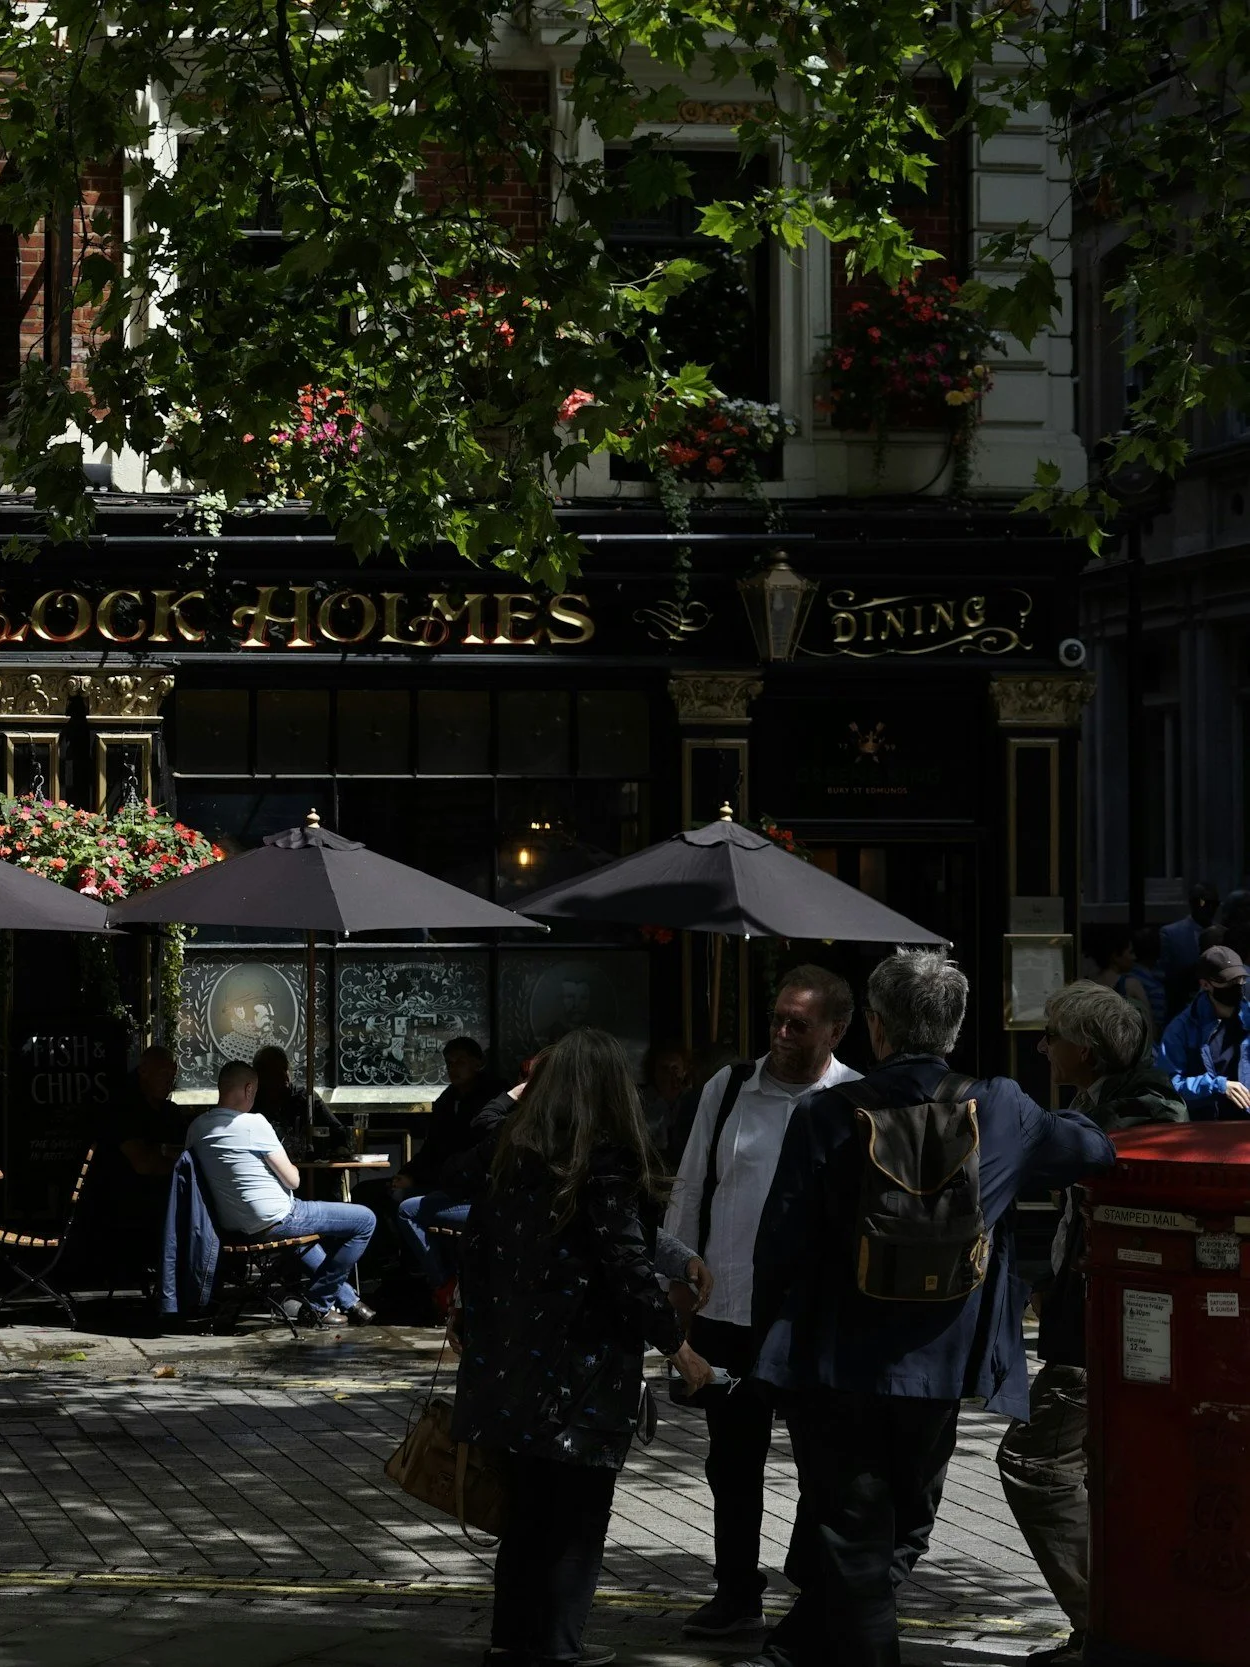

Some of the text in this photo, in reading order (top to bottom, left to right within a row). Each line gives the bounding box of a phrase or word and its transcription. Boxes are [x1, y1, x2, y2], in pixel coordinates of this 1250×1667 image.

[231, 584, 598, 649] HOLMES
[830, 594, 988, 643] DINING
[32, 1035, 106, 1068] FISH &
[30, 1072, 110, 1105] CHIPS
[1104, 1207, 1180, 1227] STAMPED MAIL
[1130, 1343, 1138, 1351] 12
